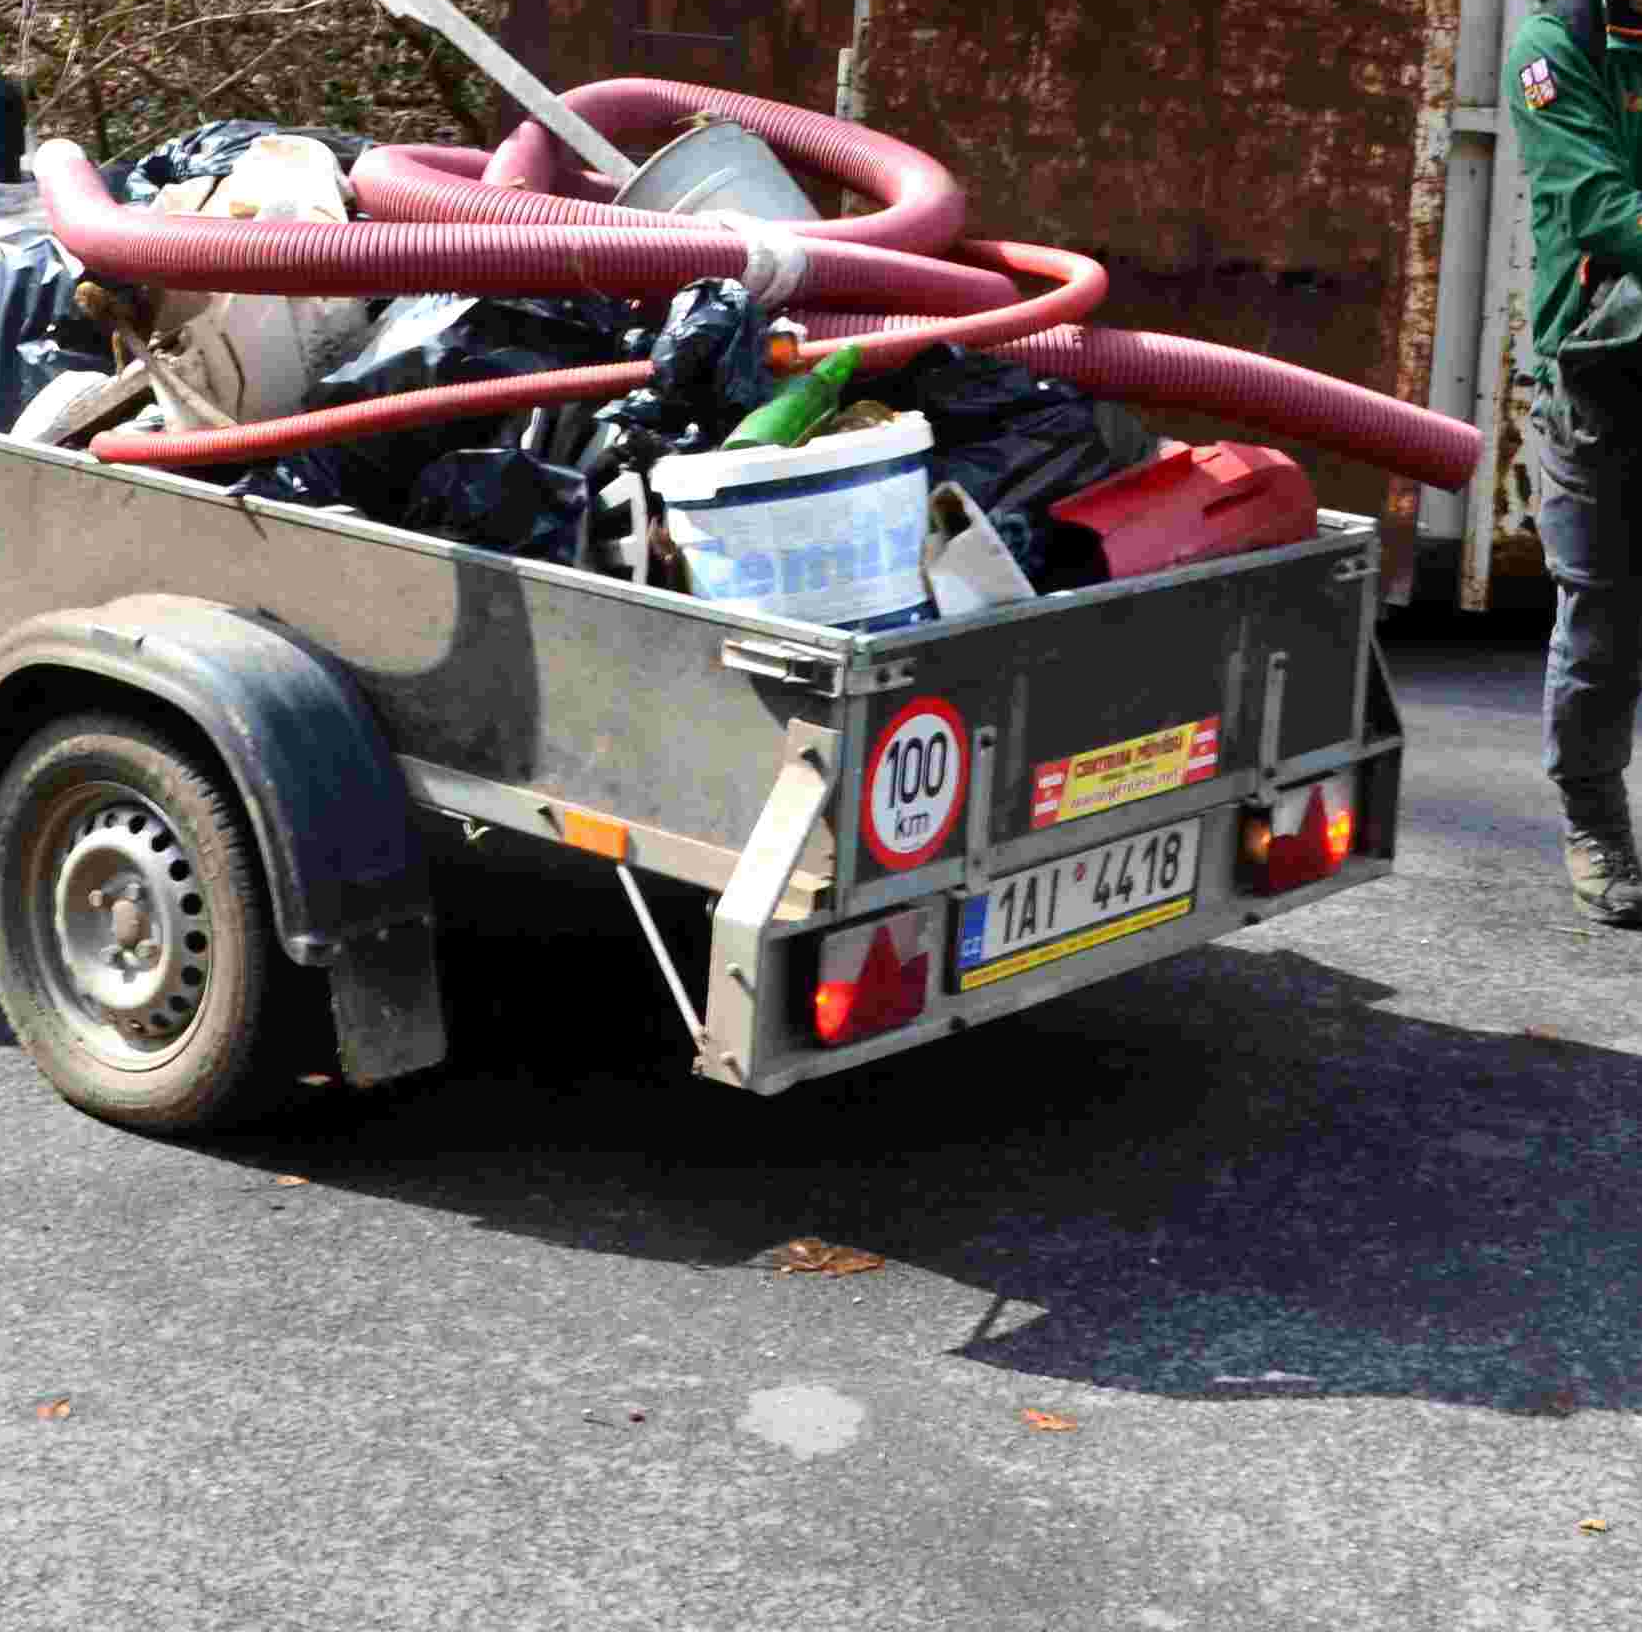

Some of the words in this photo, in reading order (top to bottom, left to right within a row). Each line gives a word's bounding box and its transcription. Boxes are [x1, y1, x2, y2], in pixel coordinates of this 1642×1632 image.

[886, 731, 948, 809] 100
[894, 809, 931, 840] km
[1092, 831, 1182, 910] 4418
